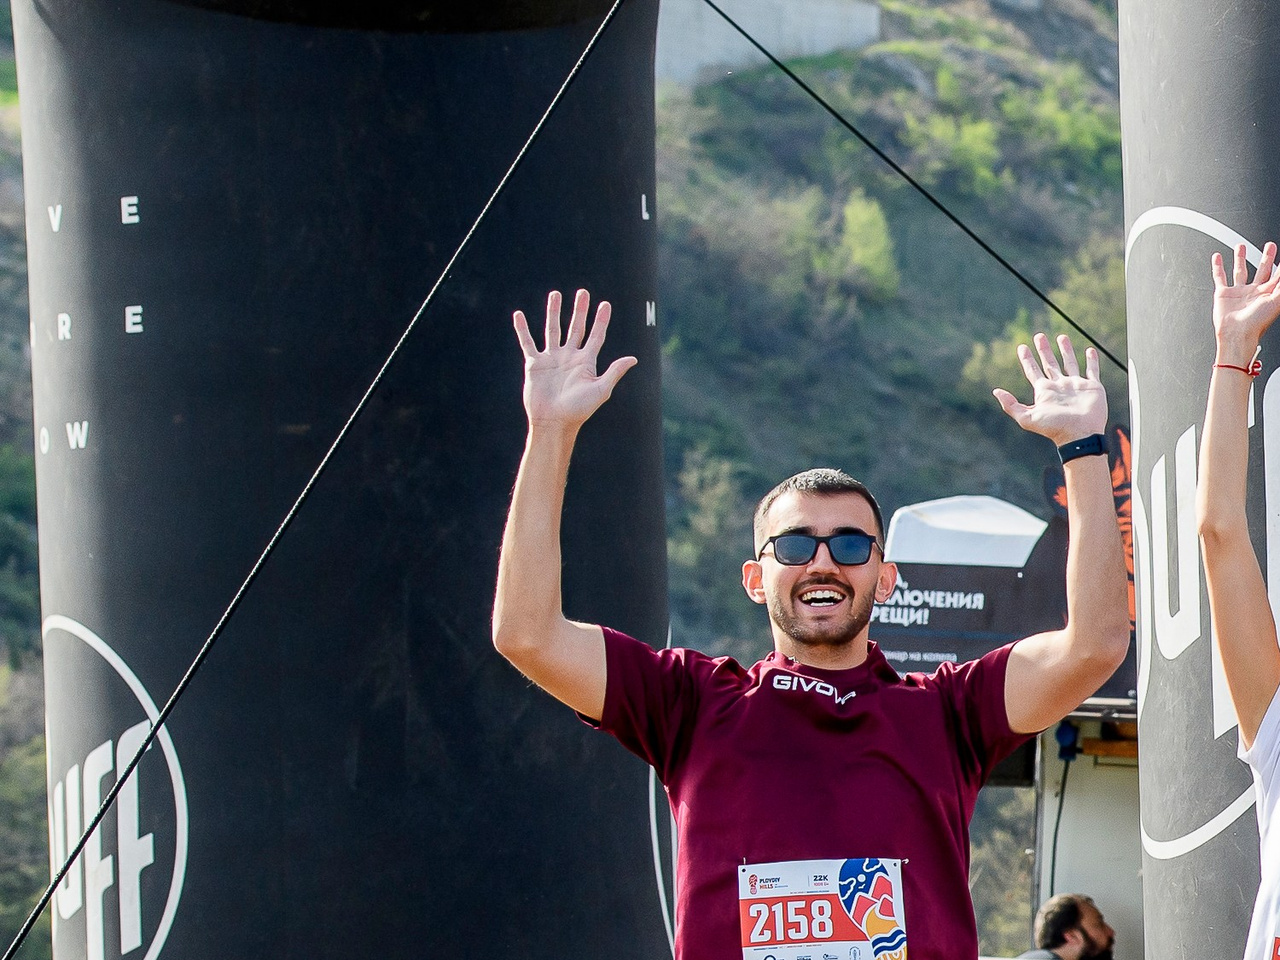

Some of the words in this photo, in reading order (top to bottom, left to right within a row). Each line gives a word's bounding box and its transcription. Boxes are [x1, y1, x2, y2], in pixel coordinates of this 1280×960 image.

[875, 589, 985, 610] ЛЮЧЕНИЯ
[813, 874, 829, 882] 22K
[749, 899, 834, 944] 2158
